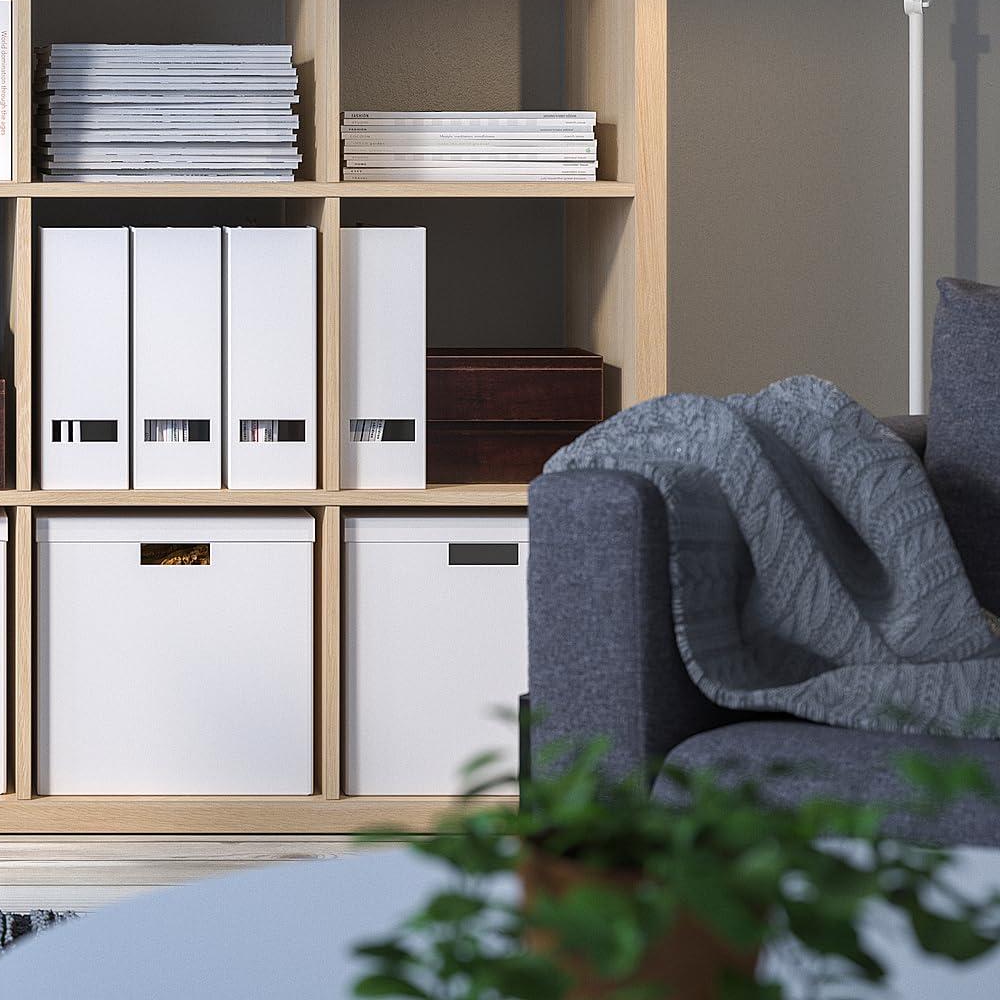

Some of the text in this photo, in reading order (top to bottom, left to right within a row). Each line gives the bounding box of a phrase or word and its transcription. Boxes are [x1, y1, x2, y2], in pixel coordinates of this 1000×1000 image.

[0, 31, 8, 108] World domination through
